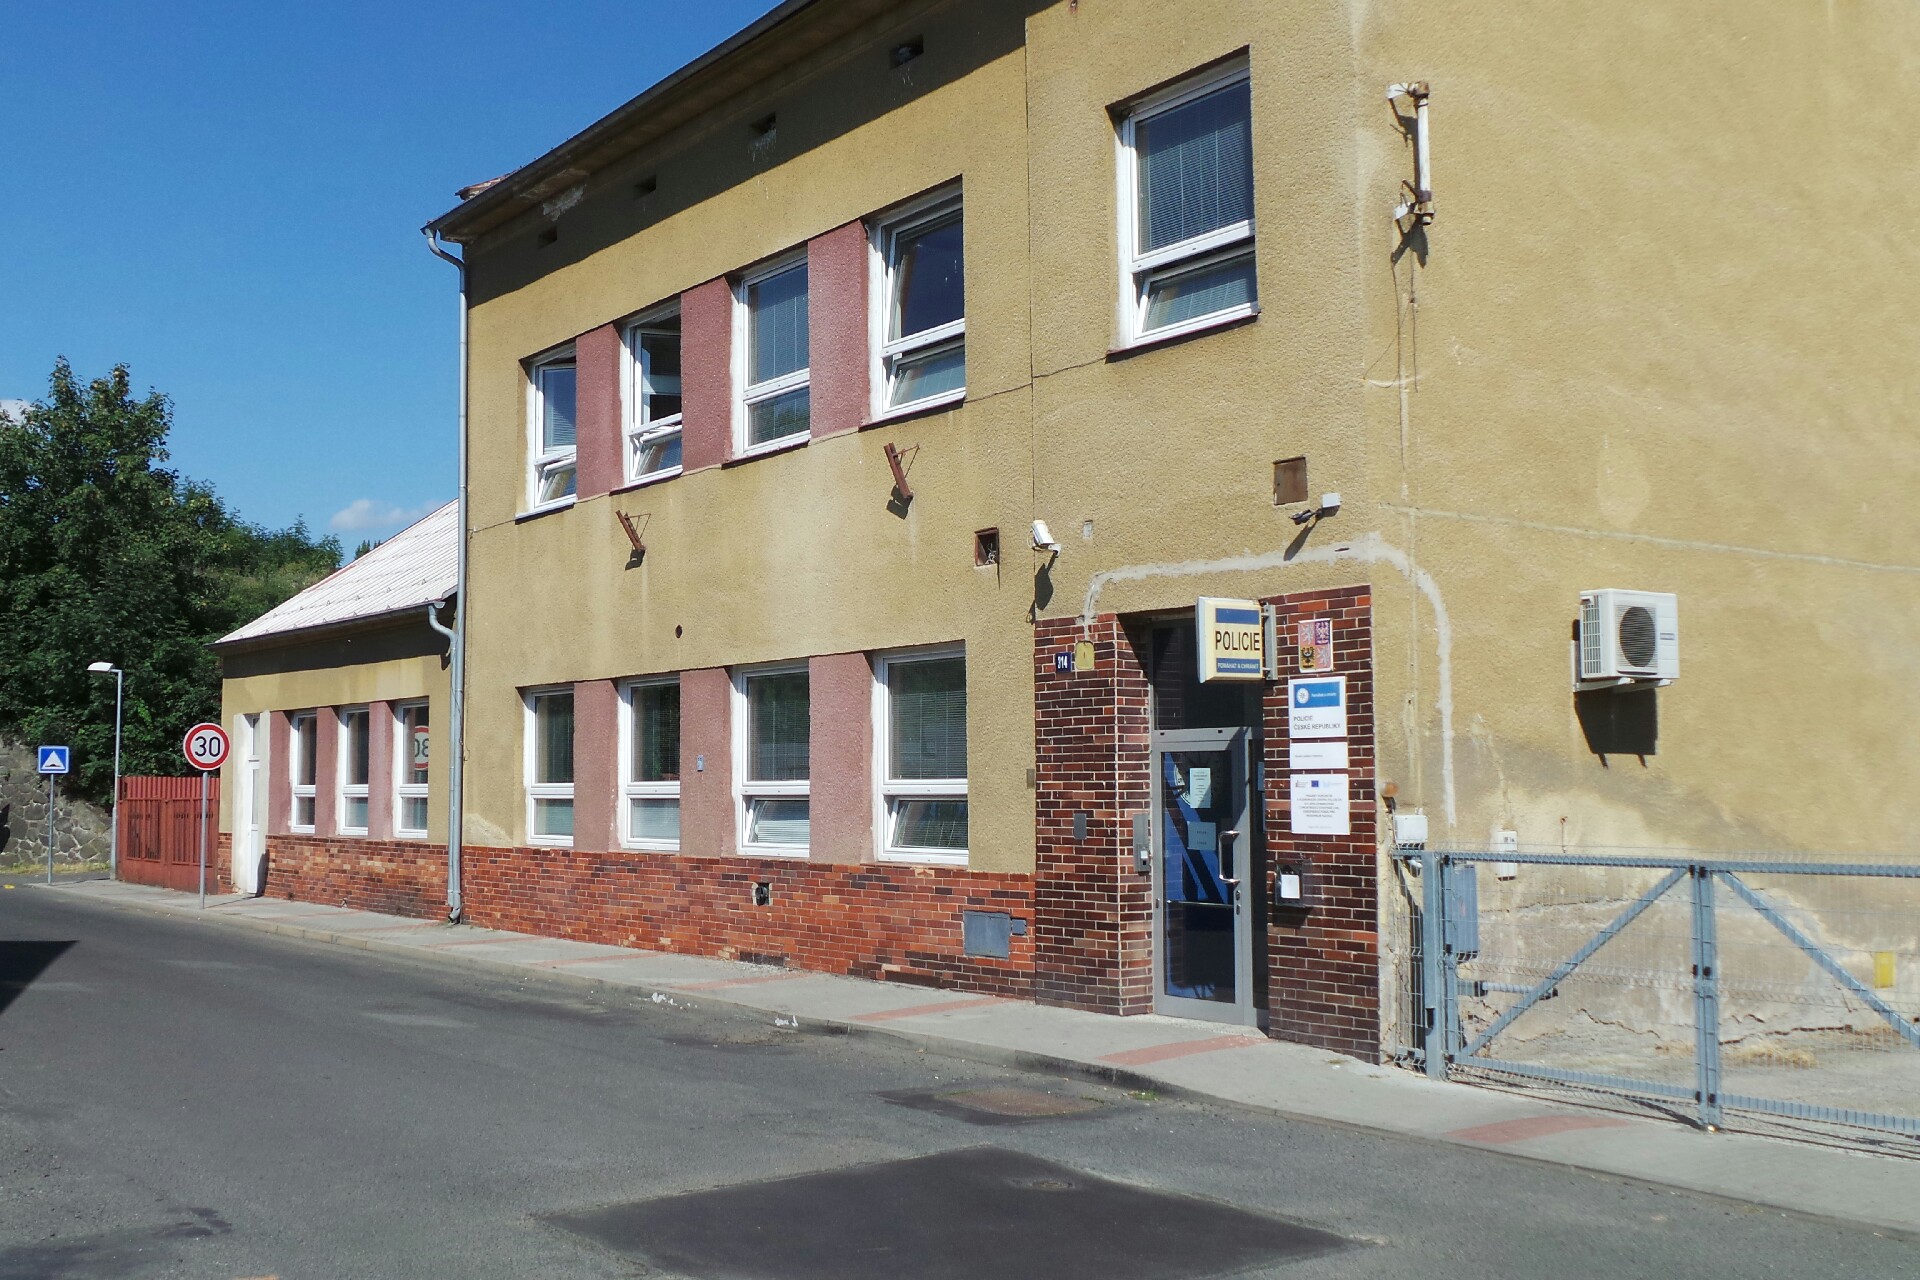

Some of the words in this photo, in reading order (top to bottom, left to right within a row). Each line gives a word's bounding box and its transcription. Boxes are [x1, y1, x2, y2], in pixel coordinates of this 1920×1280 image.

[1215, 630, 1260, 651] POLICIE
[1057, 655, 1068, 668] 314
[194, 736, 221, 757] 30
